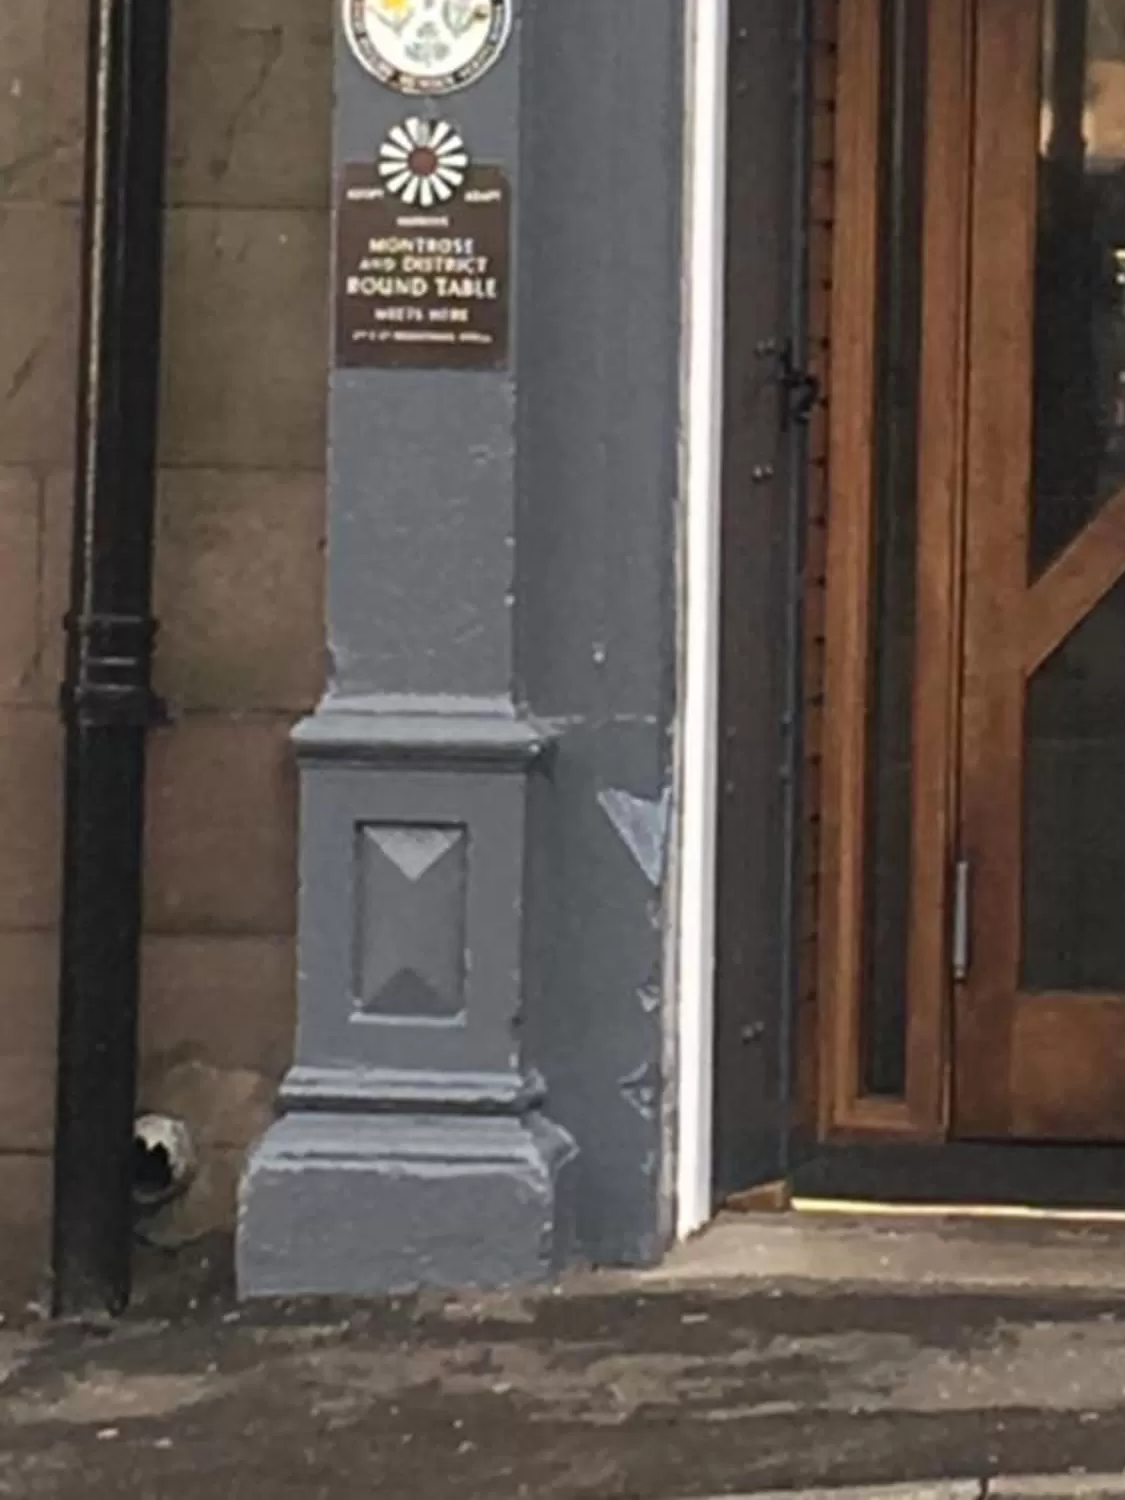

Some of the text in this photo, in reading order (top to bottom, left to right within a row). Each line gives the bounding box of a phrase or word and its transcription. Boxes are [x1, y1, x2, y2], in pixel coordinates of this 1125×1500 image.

[369, 238, 474, 253] MONTROSE
[359, 256, 488, 273] AND DISTRICT
[346, 277, 497, 298] ROUND TABLE
